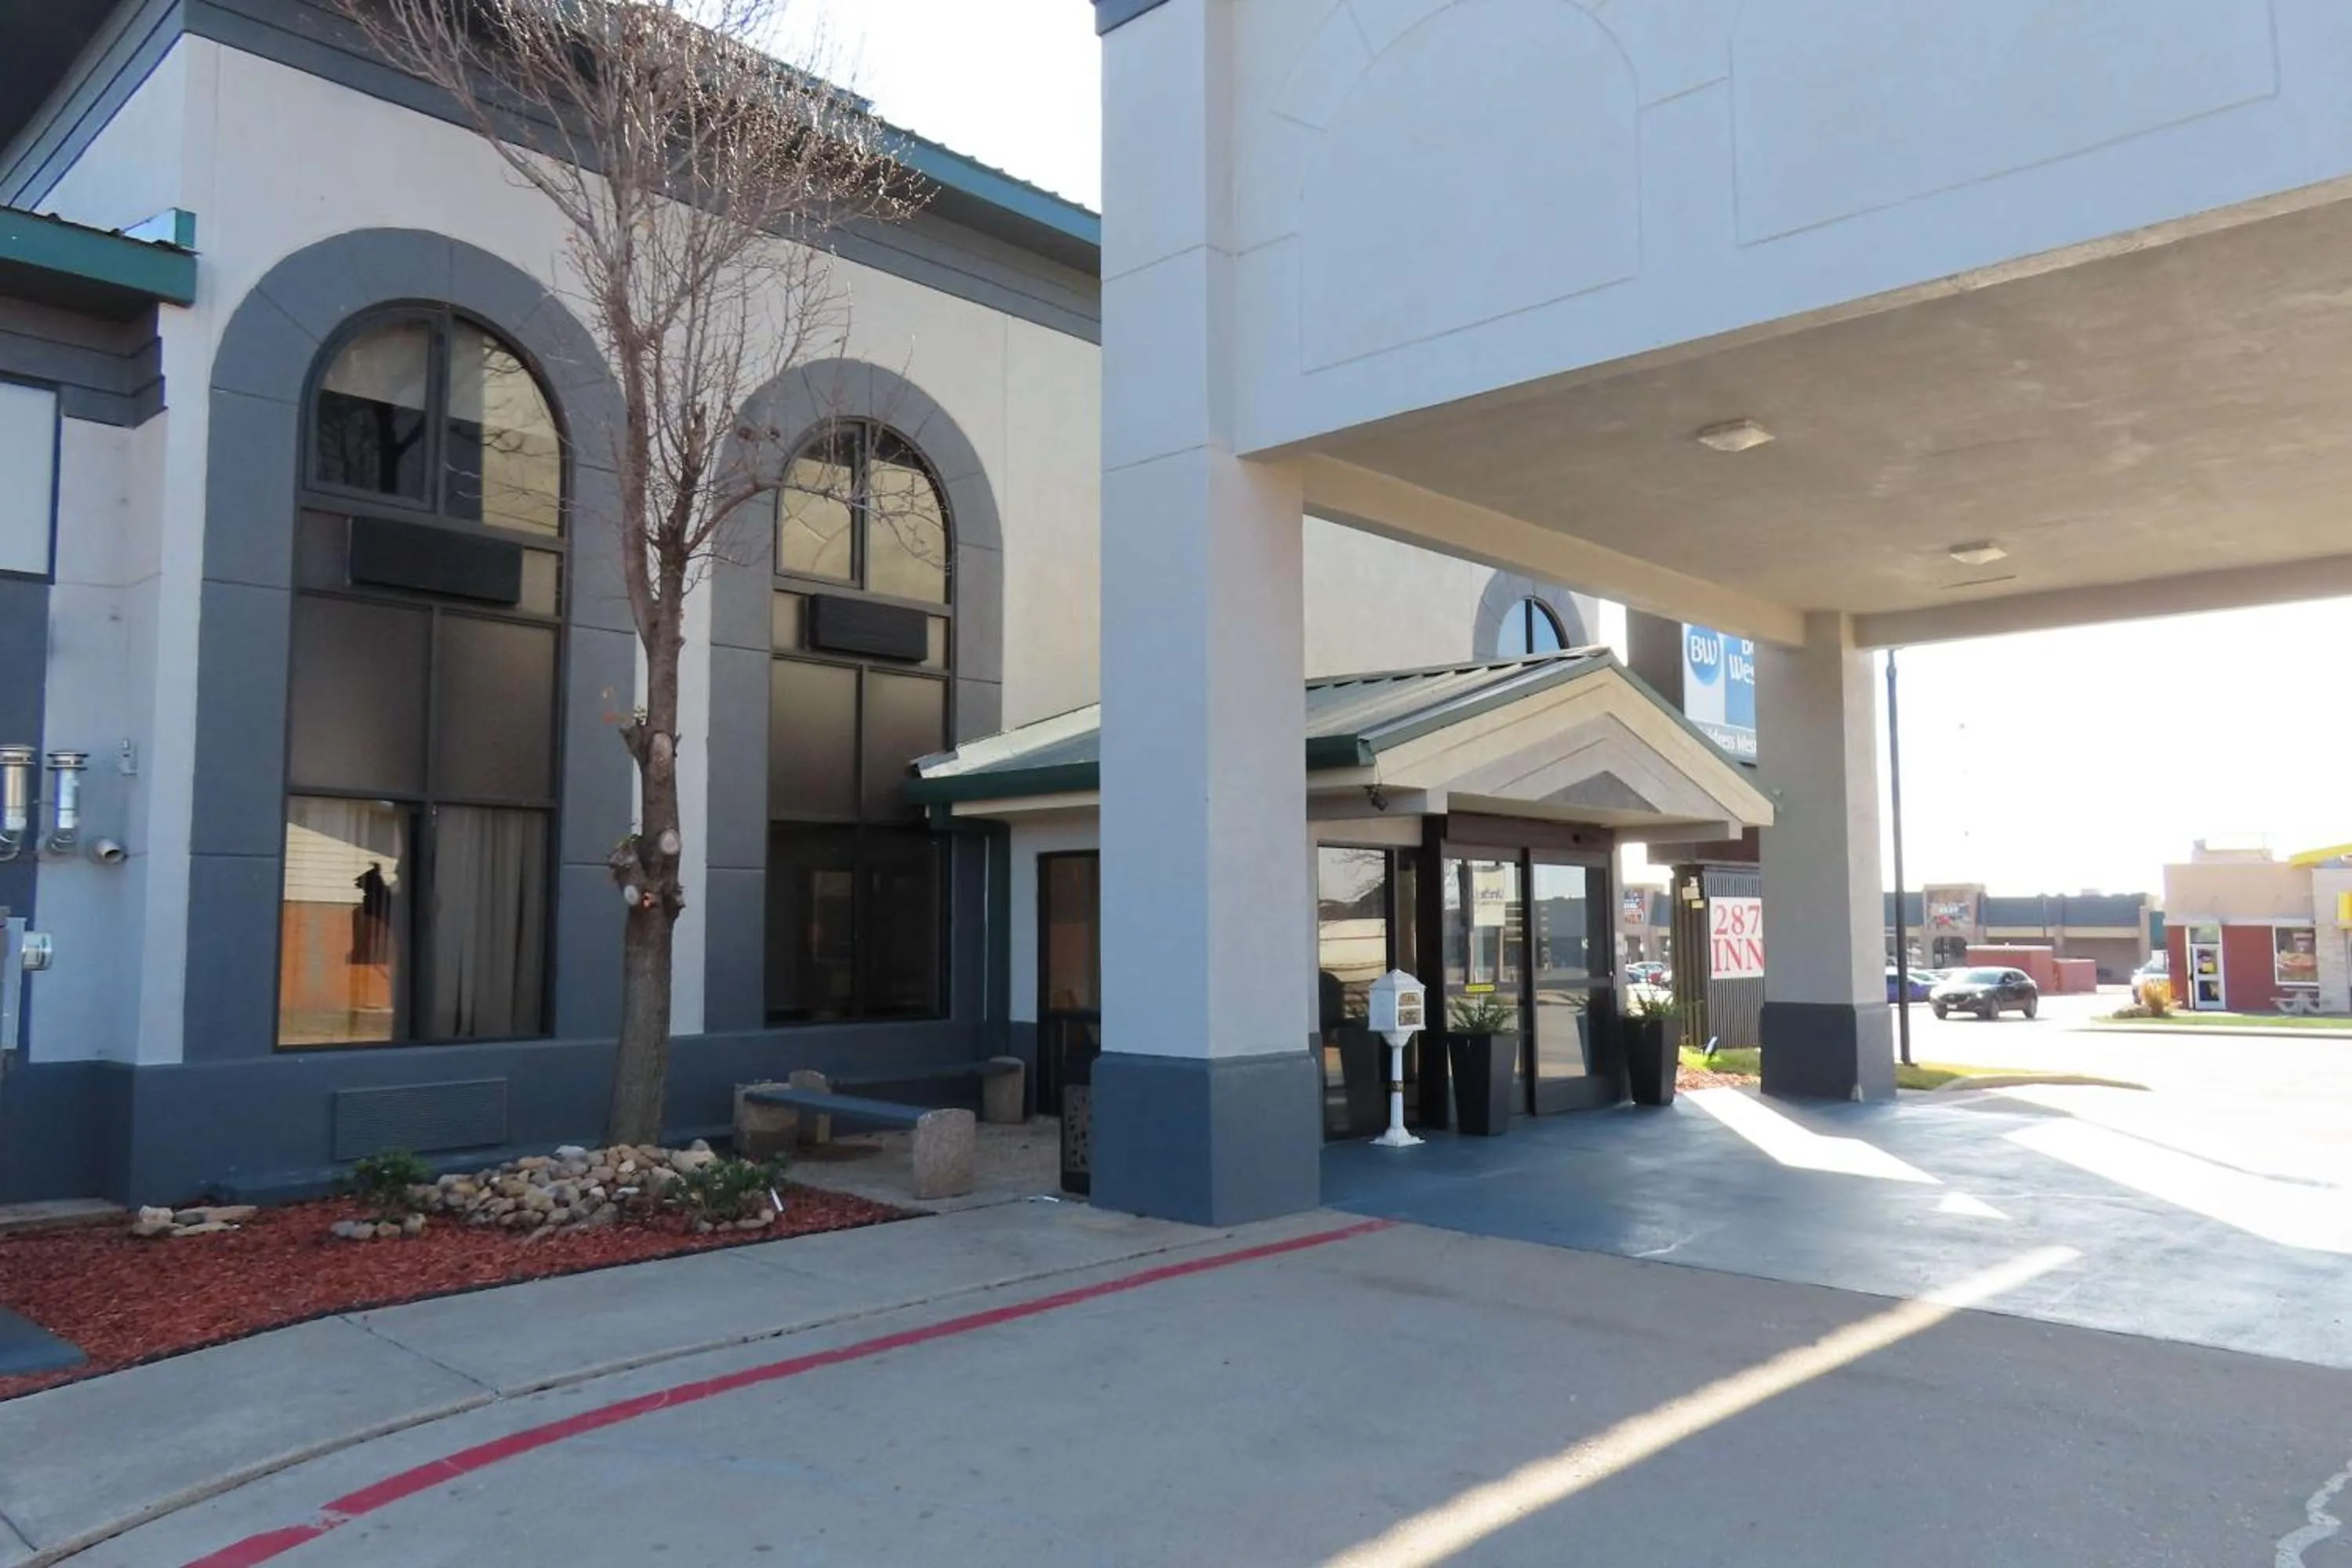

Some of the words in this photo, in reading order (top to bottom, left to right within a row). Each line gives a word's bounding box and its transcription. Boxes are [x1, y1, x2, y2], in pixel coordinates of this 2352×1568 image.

[1691, 636, 1718, 665] BW
[1714, 904, 1760, 935] 287
[1712, 938, 1766, 971] INN
